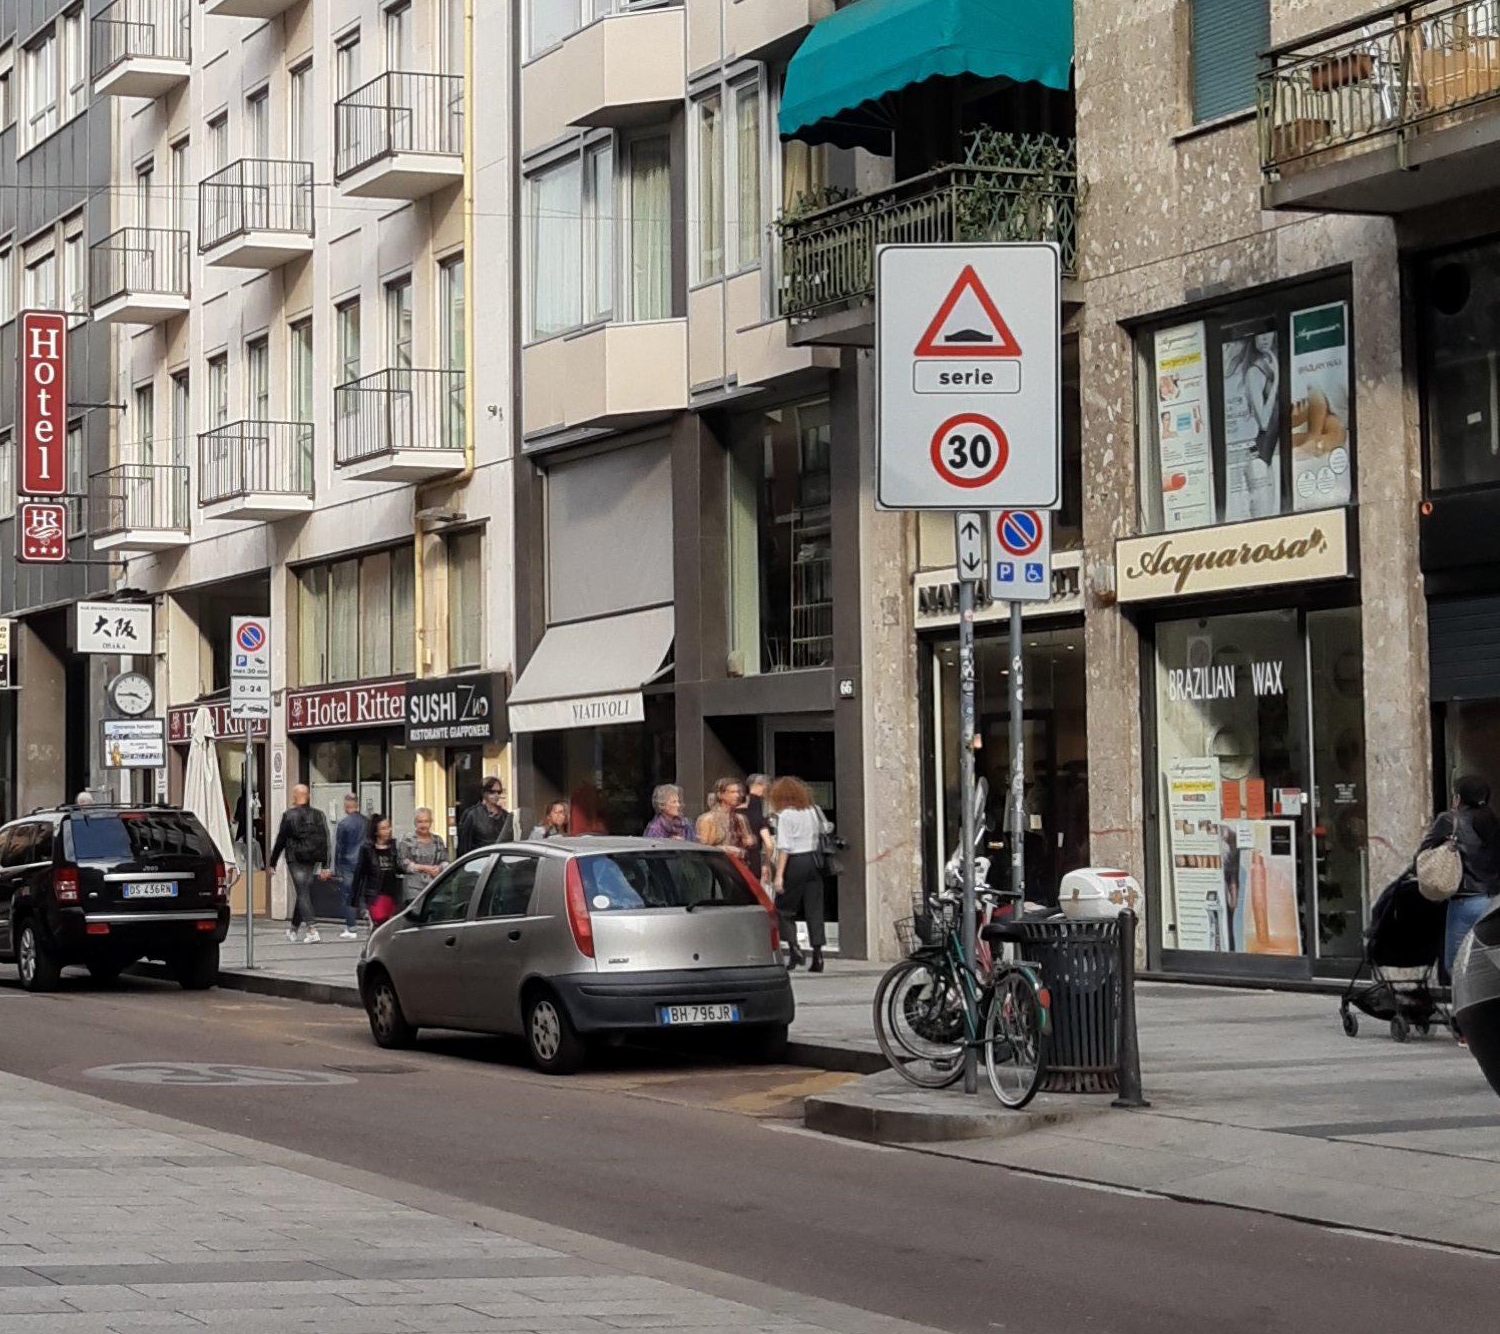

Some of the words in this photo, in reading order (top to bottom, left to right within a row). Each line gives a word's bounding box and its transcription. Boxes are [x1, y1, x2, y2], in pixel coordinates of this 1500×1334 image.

[938, 368, 994, 386] serie
[29, 327, 60, 479] Hotel
[947, 433, 992, 470] 30
[1000, 564, 1011, 579] P
[1126, 538, 1314, 593] Acquarosa
[92, 615, 138, 640] 大阪
[840, 679, 853, 695] 66
[1168, 665, 1236, 701] BRAZILIAN
[1251, 660, 1284, 696] WAX
[306, 690, 352, 727] Hotel
[356, 688, 406, 722] Ritter
[410, 692, 457, 724] SUSHI
[410, 726, 448, 741] RISTORANTE
[449, 723, 491, 738] GIAPPONESE
[671, 1006, 688, 1022] BH
